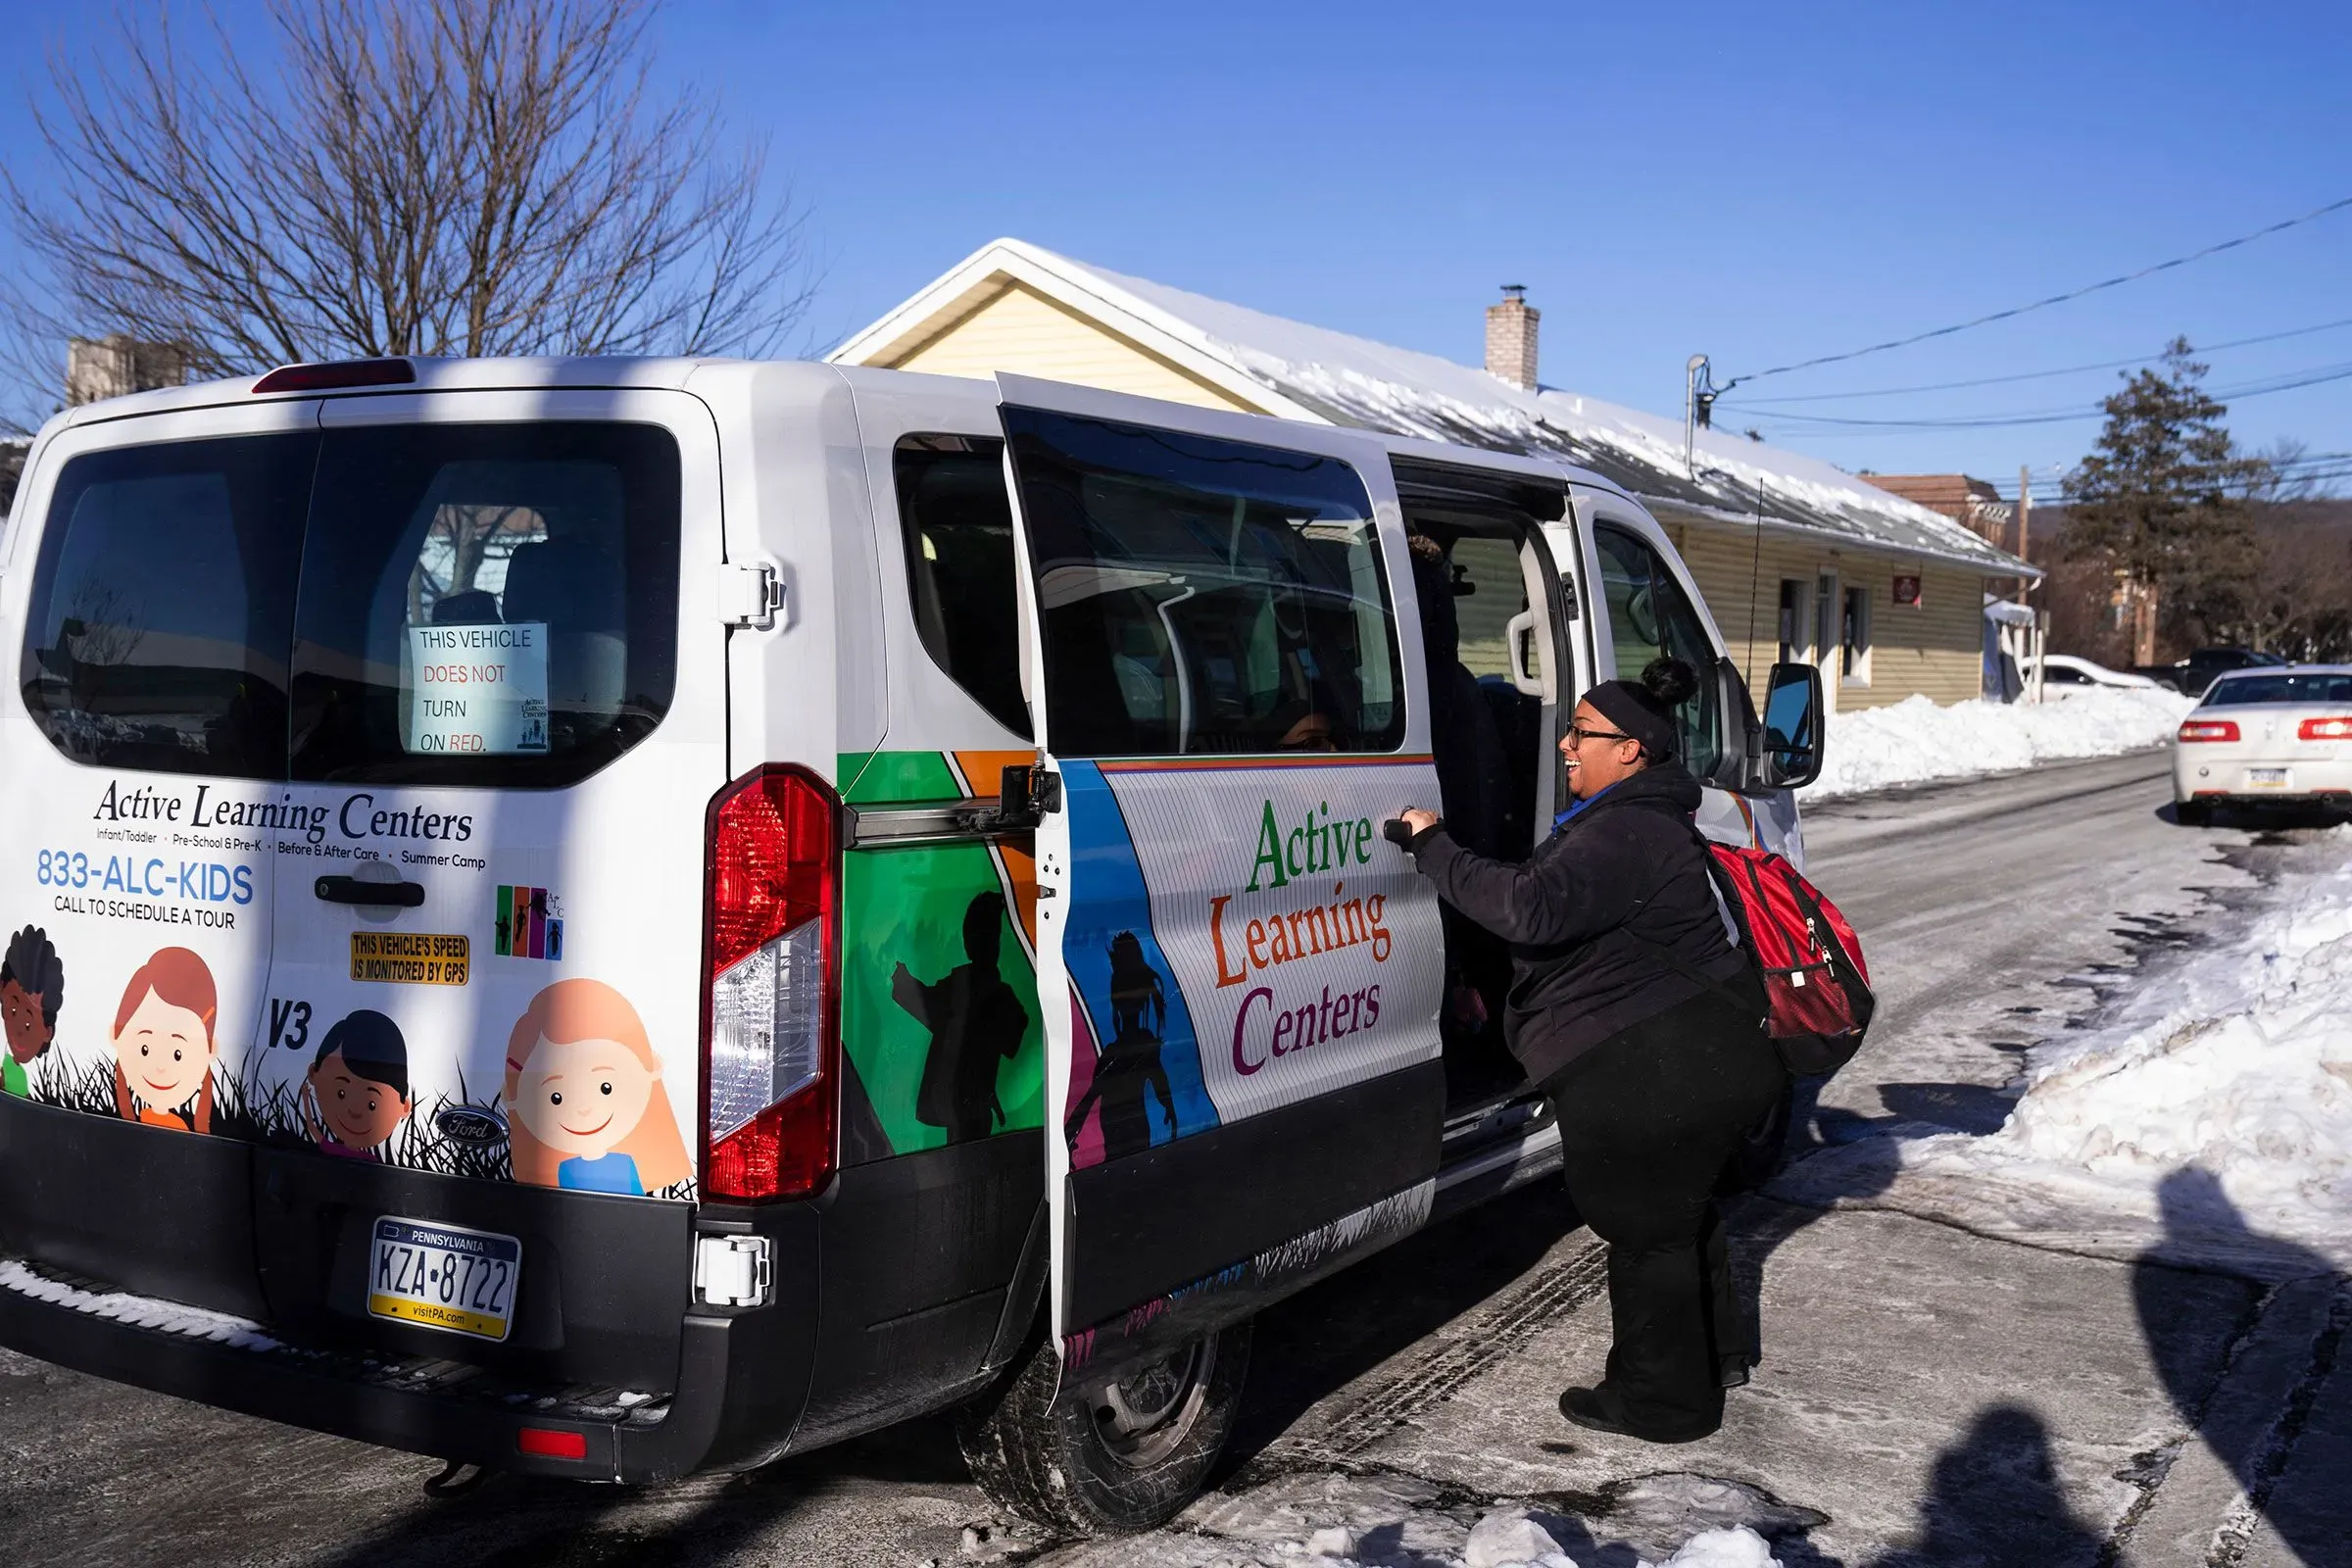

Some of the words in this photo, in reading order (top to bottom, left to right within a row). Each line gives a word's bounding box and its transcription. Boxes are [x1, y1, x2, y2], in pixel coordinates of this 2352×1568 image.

[420, 631, 457, 648] THIS
[460, 630, 531, 648] VEHICLE
[424, 665, 467, 683] DOES
[472, 665, 506, 682] NOT
[423, 700, 466, 717] TURN
[420, 734, 445, 751] ON
[450, 734, 486, 753] RED.
[93, 780, 181, 821] Active
[190, 784, 329, 844] Learning
[339, 794, 472, 841] Centers
[97, 828, 157, 843] Infant/Toddler
[172, 833, 222, 849] Pre-School
[224, 838, 231, 850] &
[233, 838, 262, 852] Pre-K
[278, 842, 312, 856] Before
[315, 844, 321, 857] &
[323, 846, 352, 858] After
[354, 848, 379, 860] Care
[401, 851, 449, 866] Summer
[452, 855, 486, 871] Camp
[1245, 800, 1372, 893] Active
[37, 849, 253, 905] 833-ALC-KIDS
[55, 896, 85, 913] CALL
[88, 899, 106, 915] TO
[109, 901, 178, 923] SCHEDULE
[181, 909, 192, 925] A
[195, 910, 235, 929] TOUR
[353, 935, 376, 955] THIS
[379, 935, 430, 956] VEHICLE'S
[433, 937, 466, 957] SPEED
[1210, 881, 1392, 989] Learning
[354, 959, 364, 978] IS
[366, 959, 424, 980] MONITORED
[427, 962, 442, 981] BY
[444, 962, 466, 983] GPS
[269, 999, 312, 1051] V3
[1232, 984, 1380, 1076] Centers
[449, 1114, 488, 1138] Ford
[412, 1230, 484, 1252] PENNSYLVANIA
[413, 1306, 466, 1324] visitPA.com
